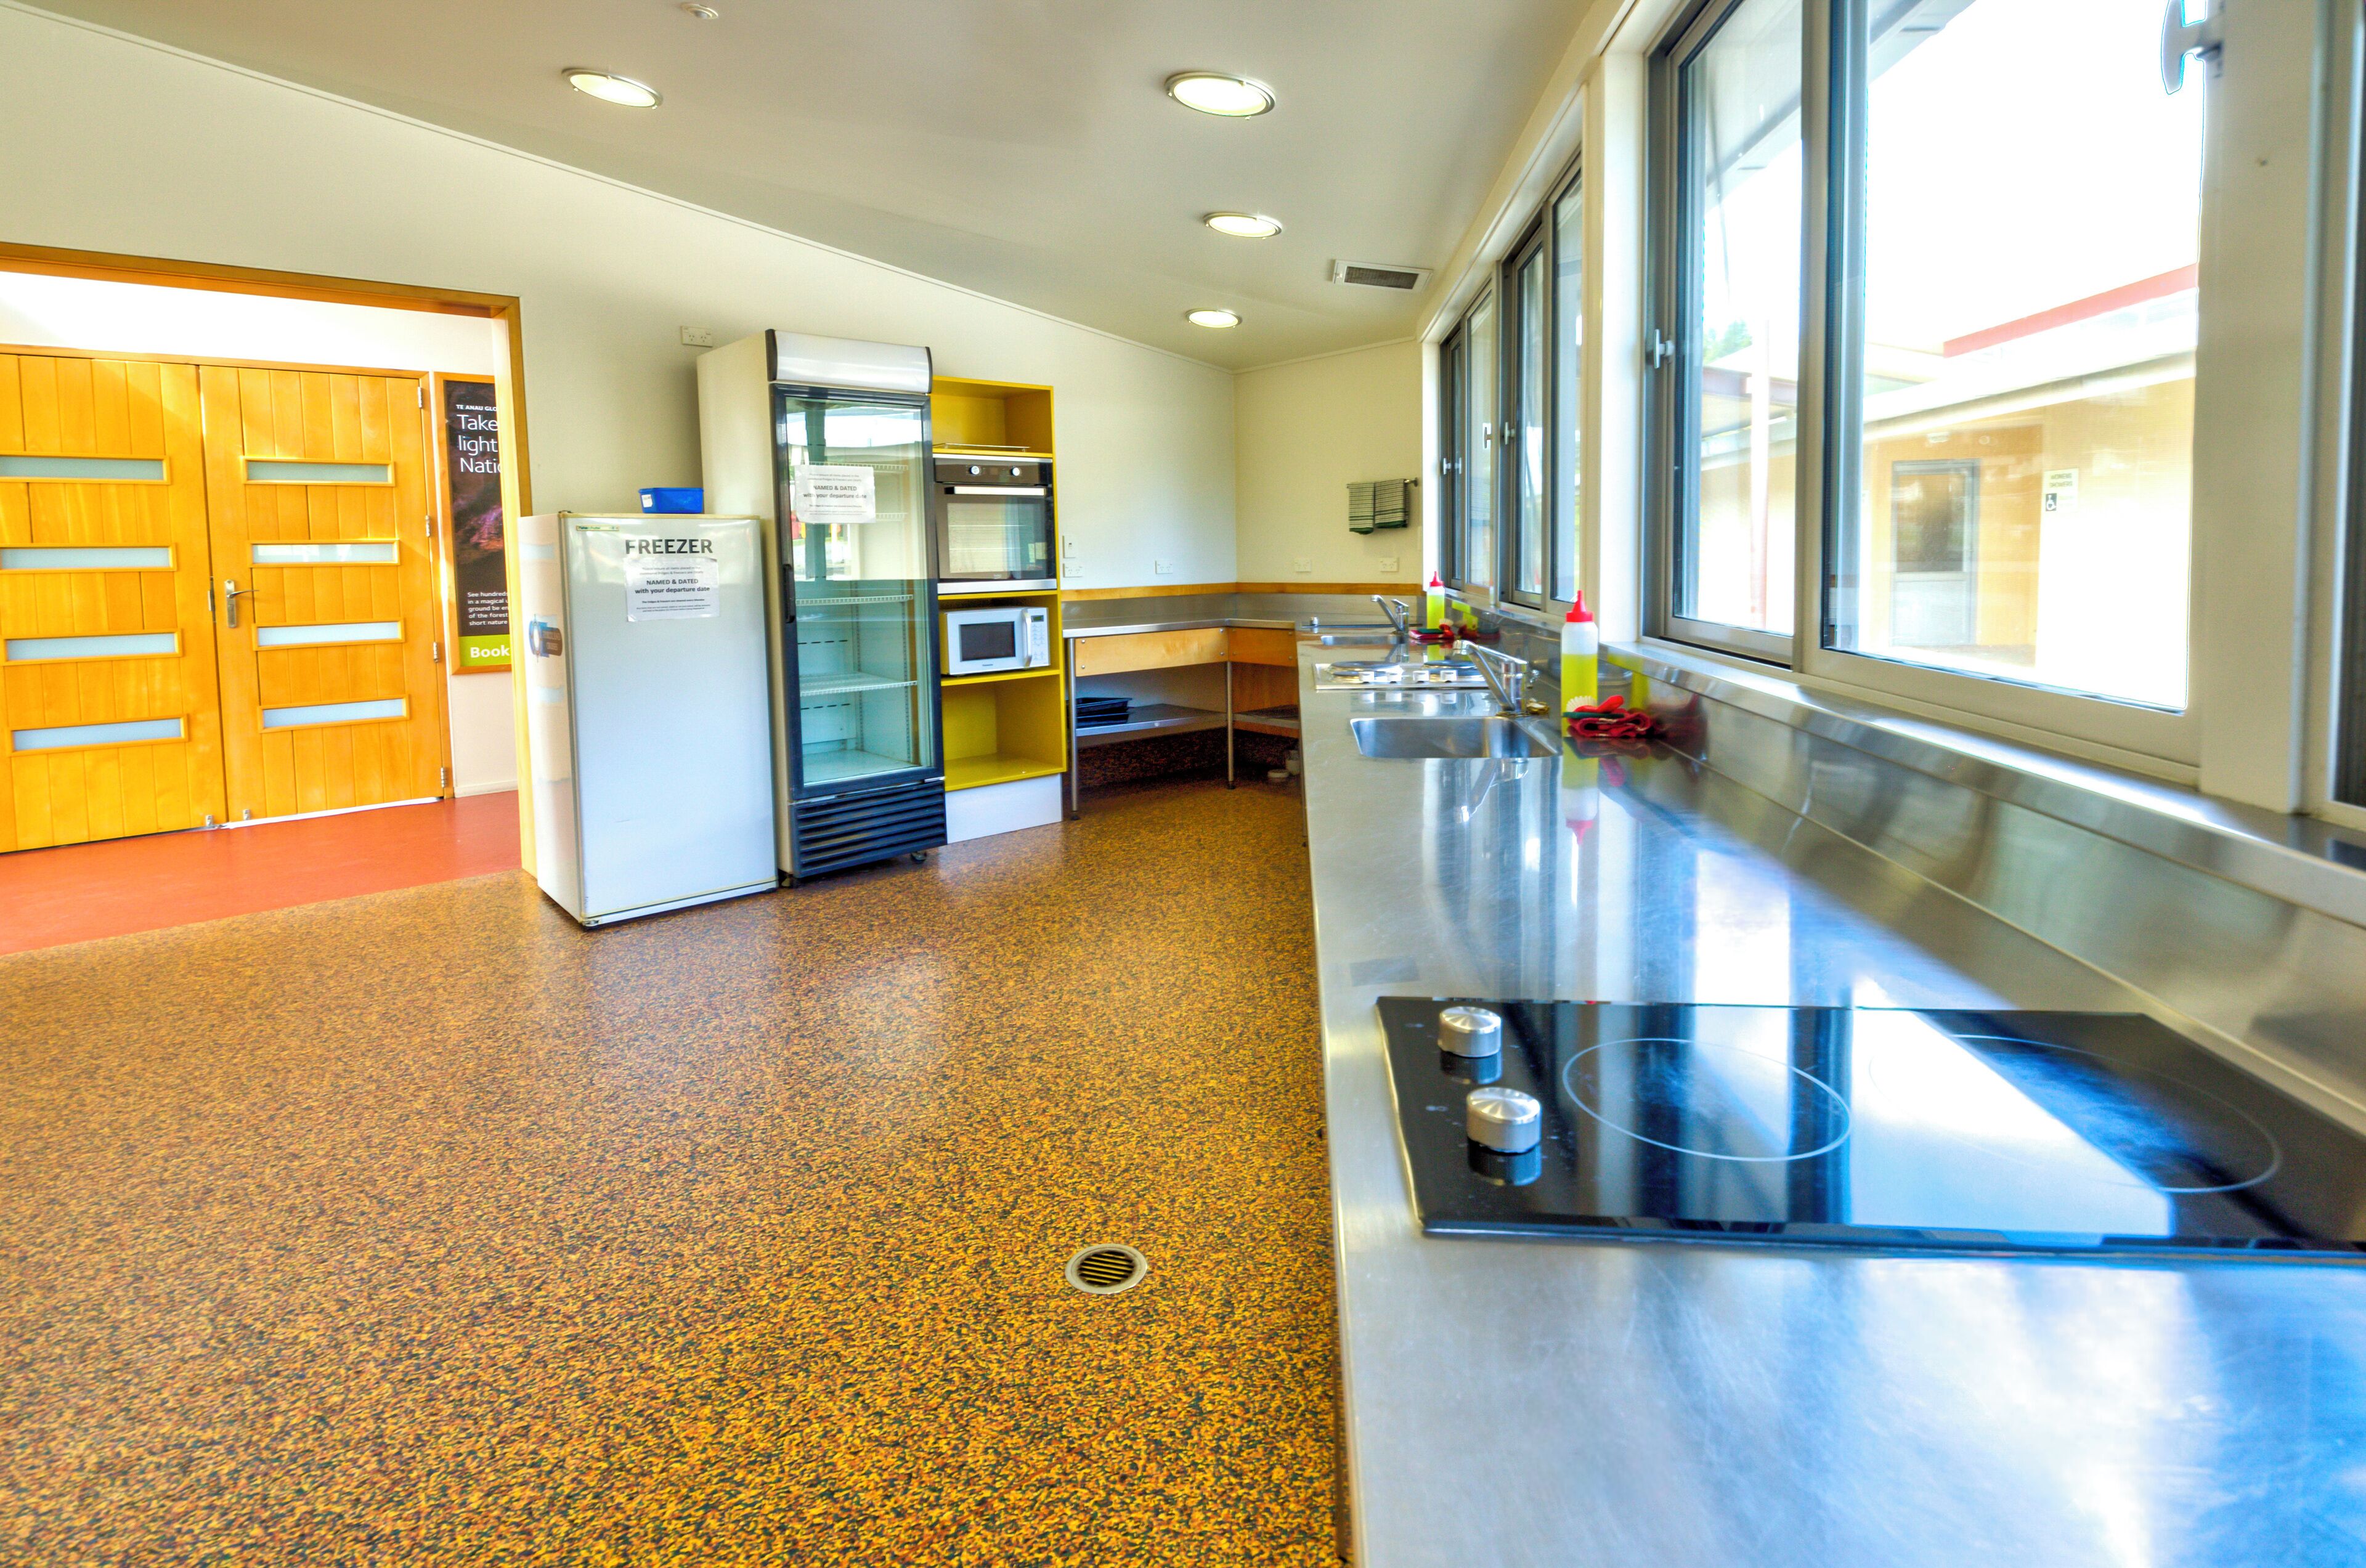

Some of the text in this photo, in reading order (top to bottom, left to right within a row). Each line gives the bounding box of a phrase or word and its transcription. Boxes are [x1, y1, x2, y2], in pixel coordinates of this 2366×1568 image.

[457, 415, 498, 431] Take
[458, 435, 498, 456] light
[625, 539, 713, 554] FREEZER
[470, 644, 510, 658] Book
